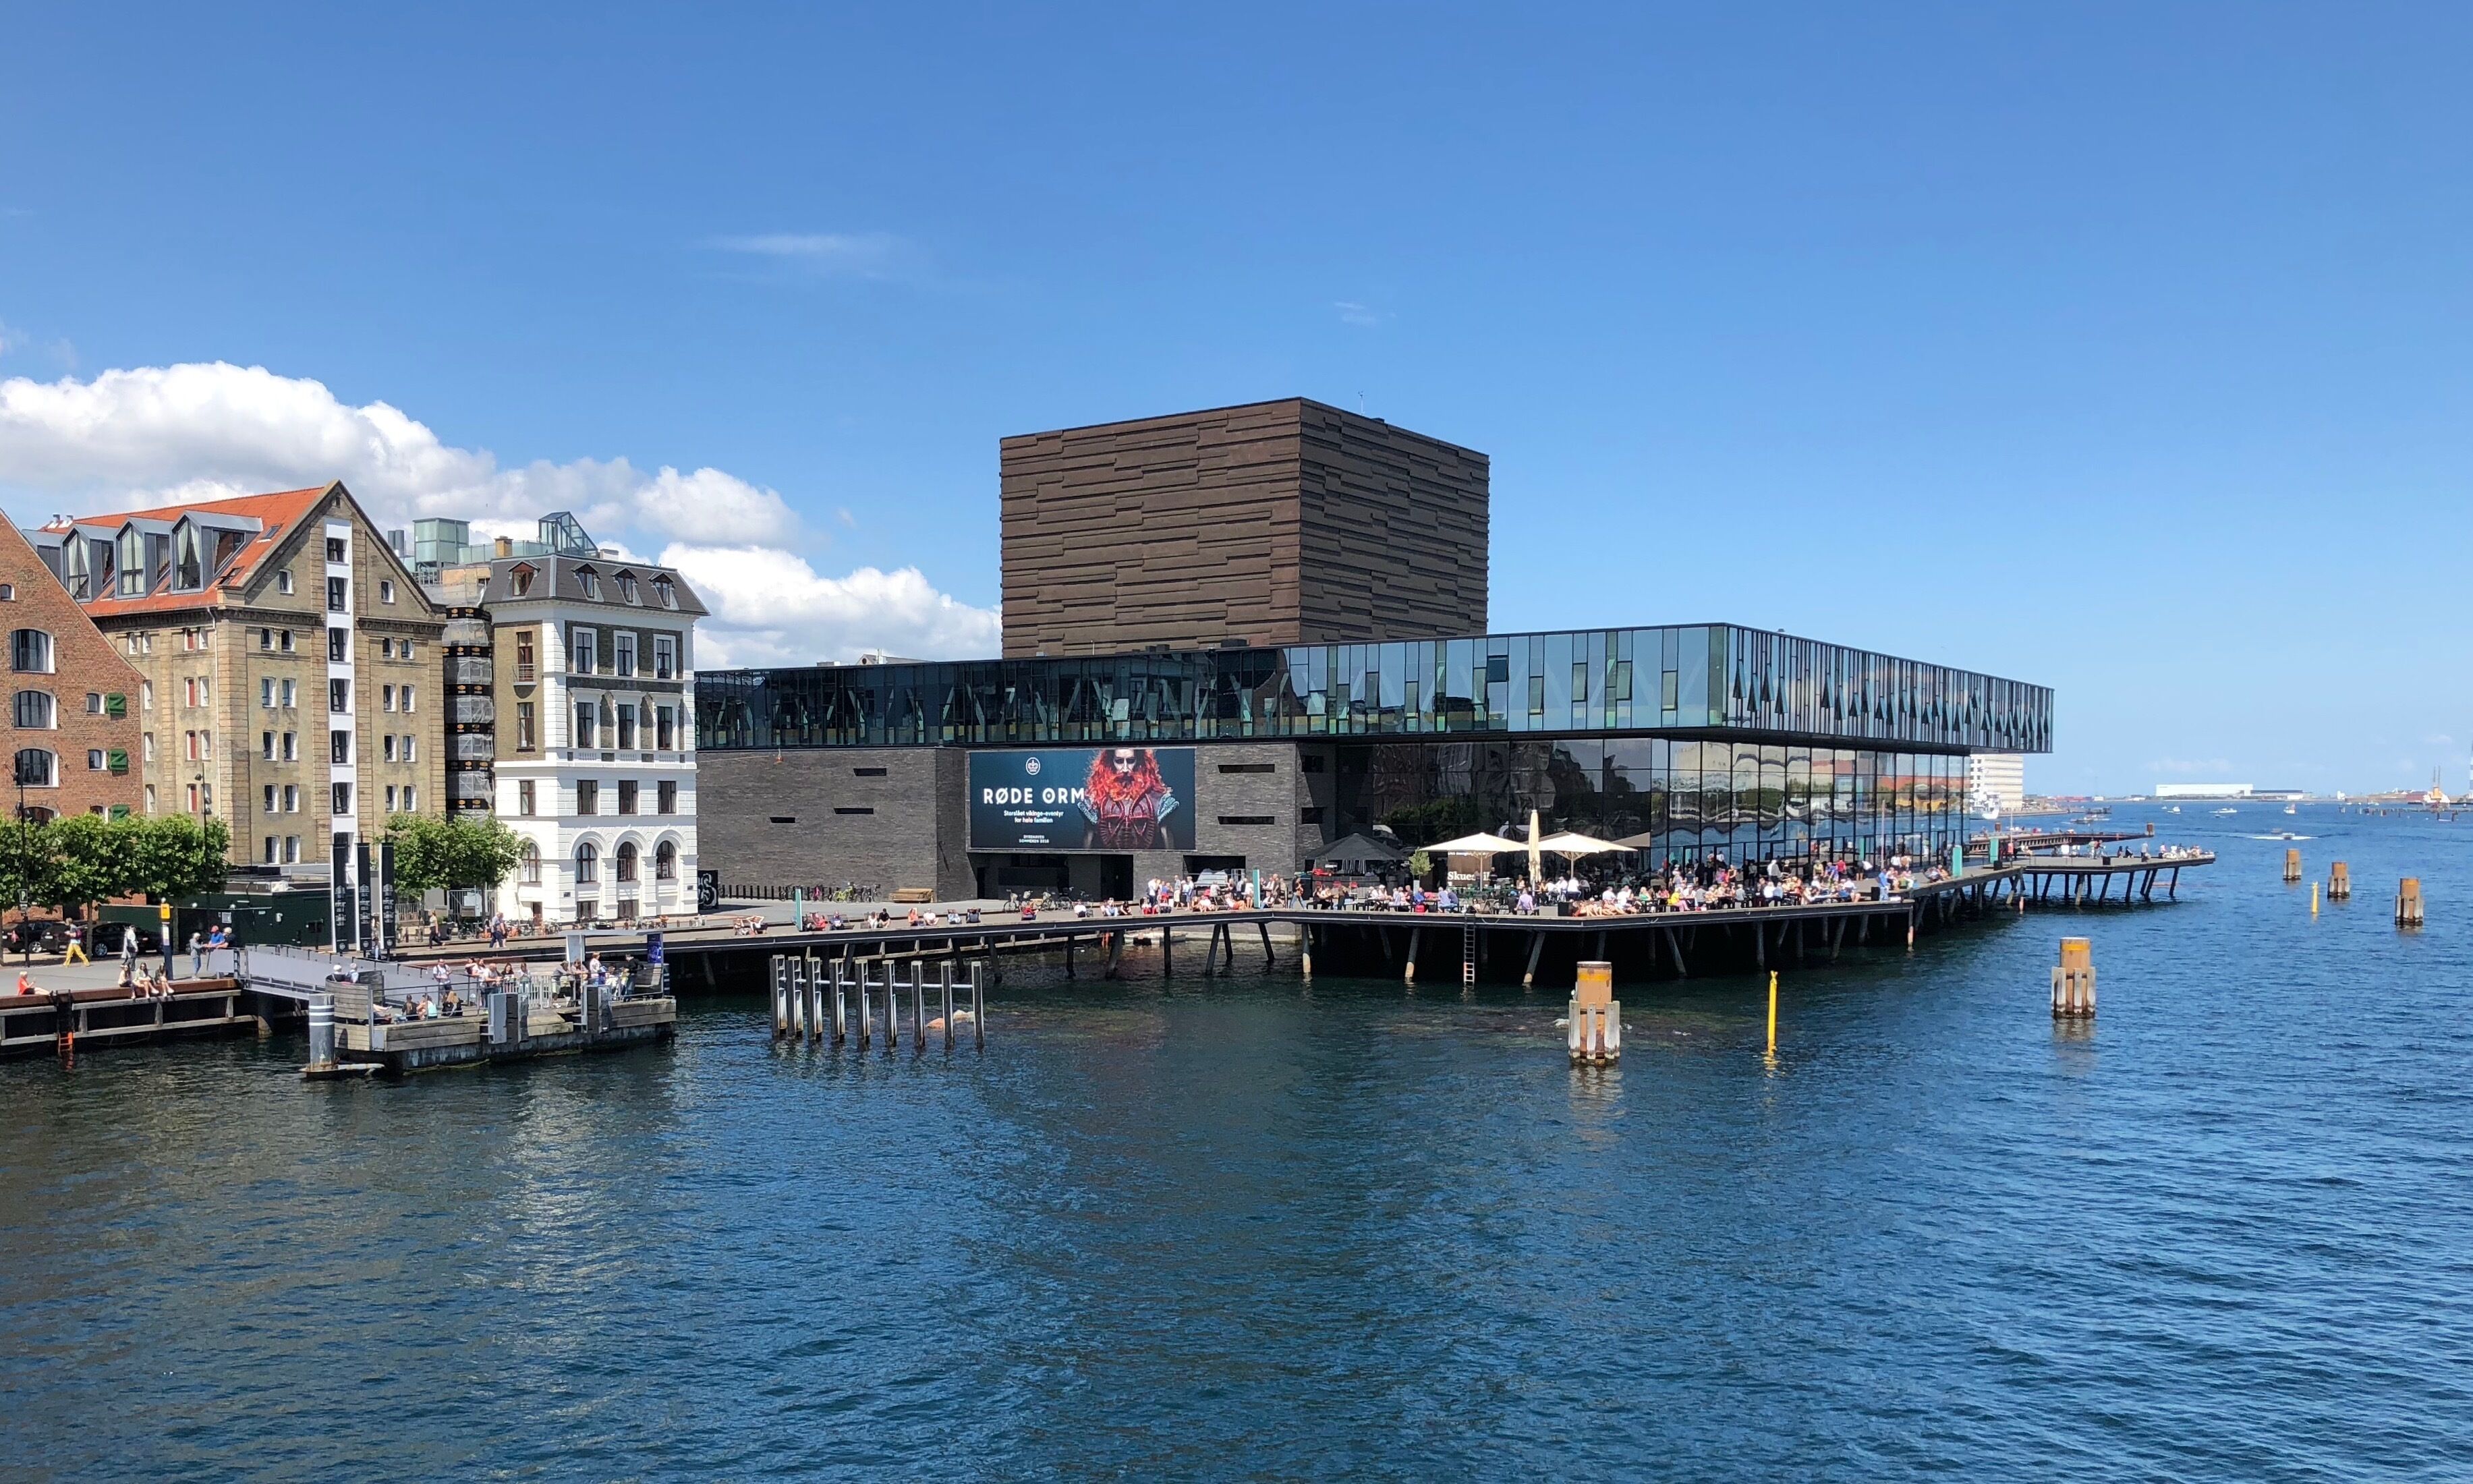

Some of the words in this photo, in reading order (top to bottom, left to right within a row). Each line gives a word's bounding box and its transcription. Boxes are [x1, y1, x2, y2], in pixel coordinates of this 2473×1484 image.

[984, 787, 1033, 805] RØDE
[1042, 788, 1085, 804] ORM
[21, 890, 26, 901] P
